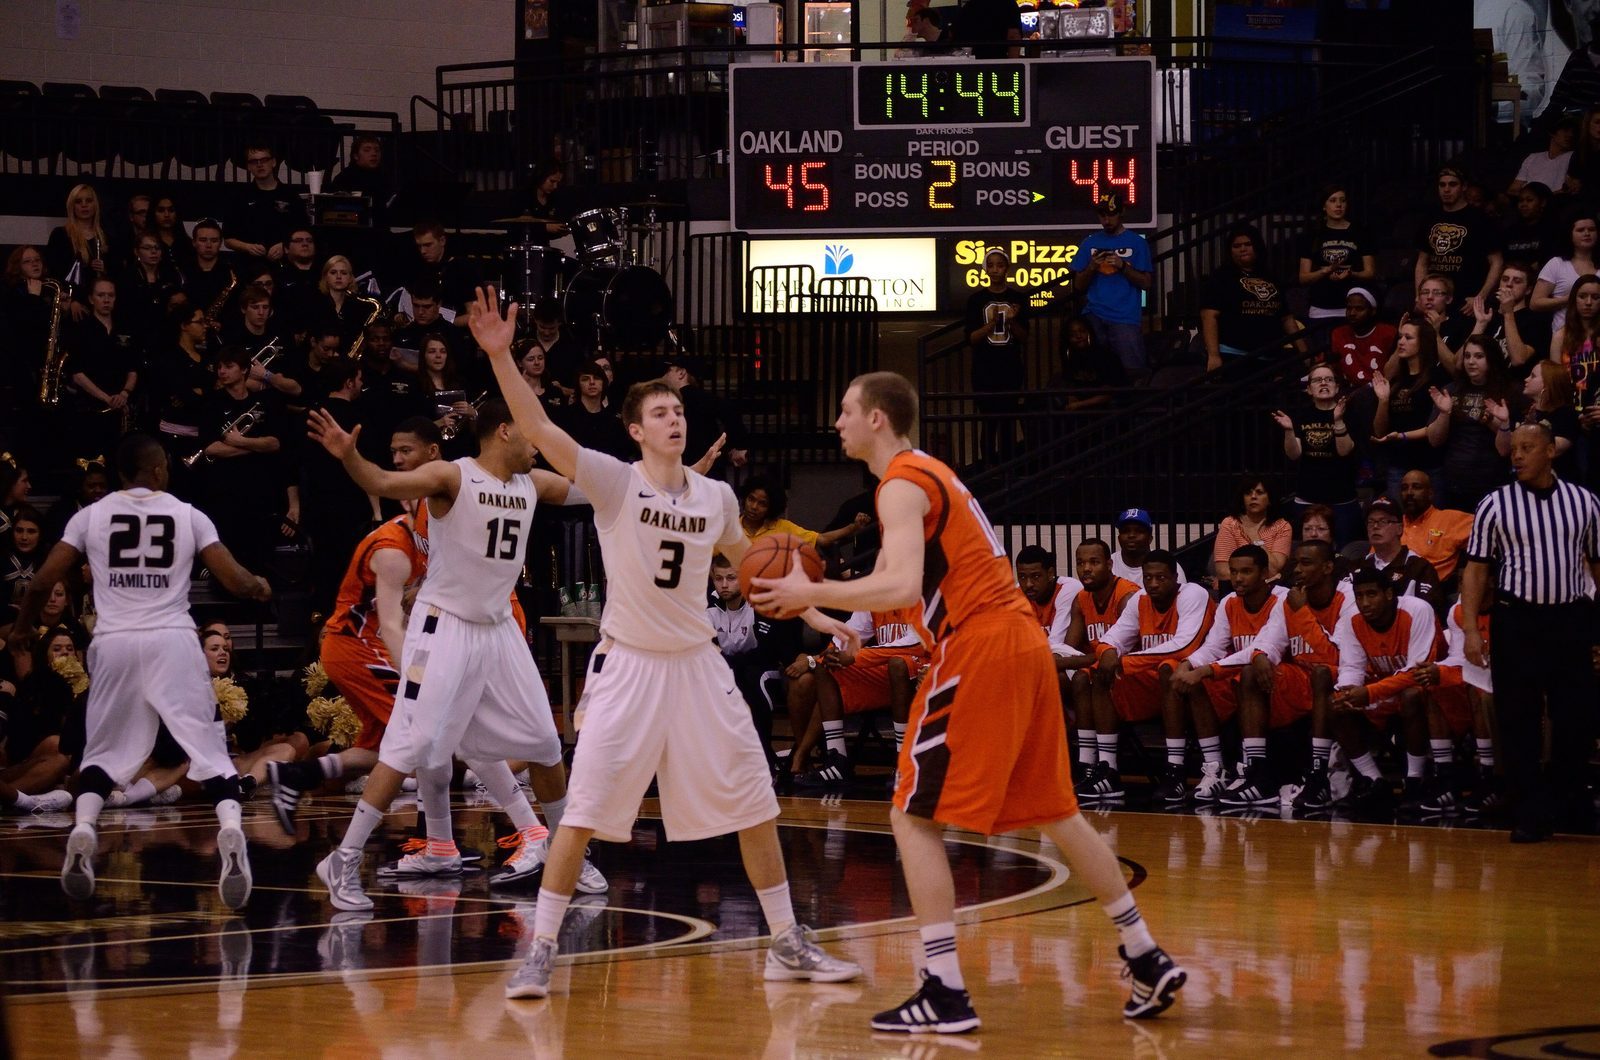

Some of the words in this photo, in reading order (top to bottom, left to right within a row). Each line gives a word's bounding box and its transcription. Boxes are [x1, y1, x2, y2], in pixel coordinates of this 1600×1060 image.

[885, 71, 1020, 118] 14:44
[740, 130, 843, 155] OAKLAND
[915, 127, 974, 135] DAKTRONICS
[1045, 124, 1139, 151] GUEST
[908, 140, 980, 157] PERIOD
[855, 163, 923, 180] BONUS
[962, 161, 1031, 178] BONUS
[1070, 158, 1136, 206] 44
[765, 161, 829, 211] 45
[928, 160, 957, 209] 2
[855, 191, 909, 208] POSS
[976, 189, 1031, 206] POSS
[966, 268, 1070, 288] 65-0500
[479, 491, 527, 510] OAKLAND
[640, 507, 707, 534] OAKLAND
[109, 514, 176, 569] 23
[485, 516, 521, 561] 15
[654, 540, 685, 590] 3
[109, 573, 170, 589] HAMILTON
